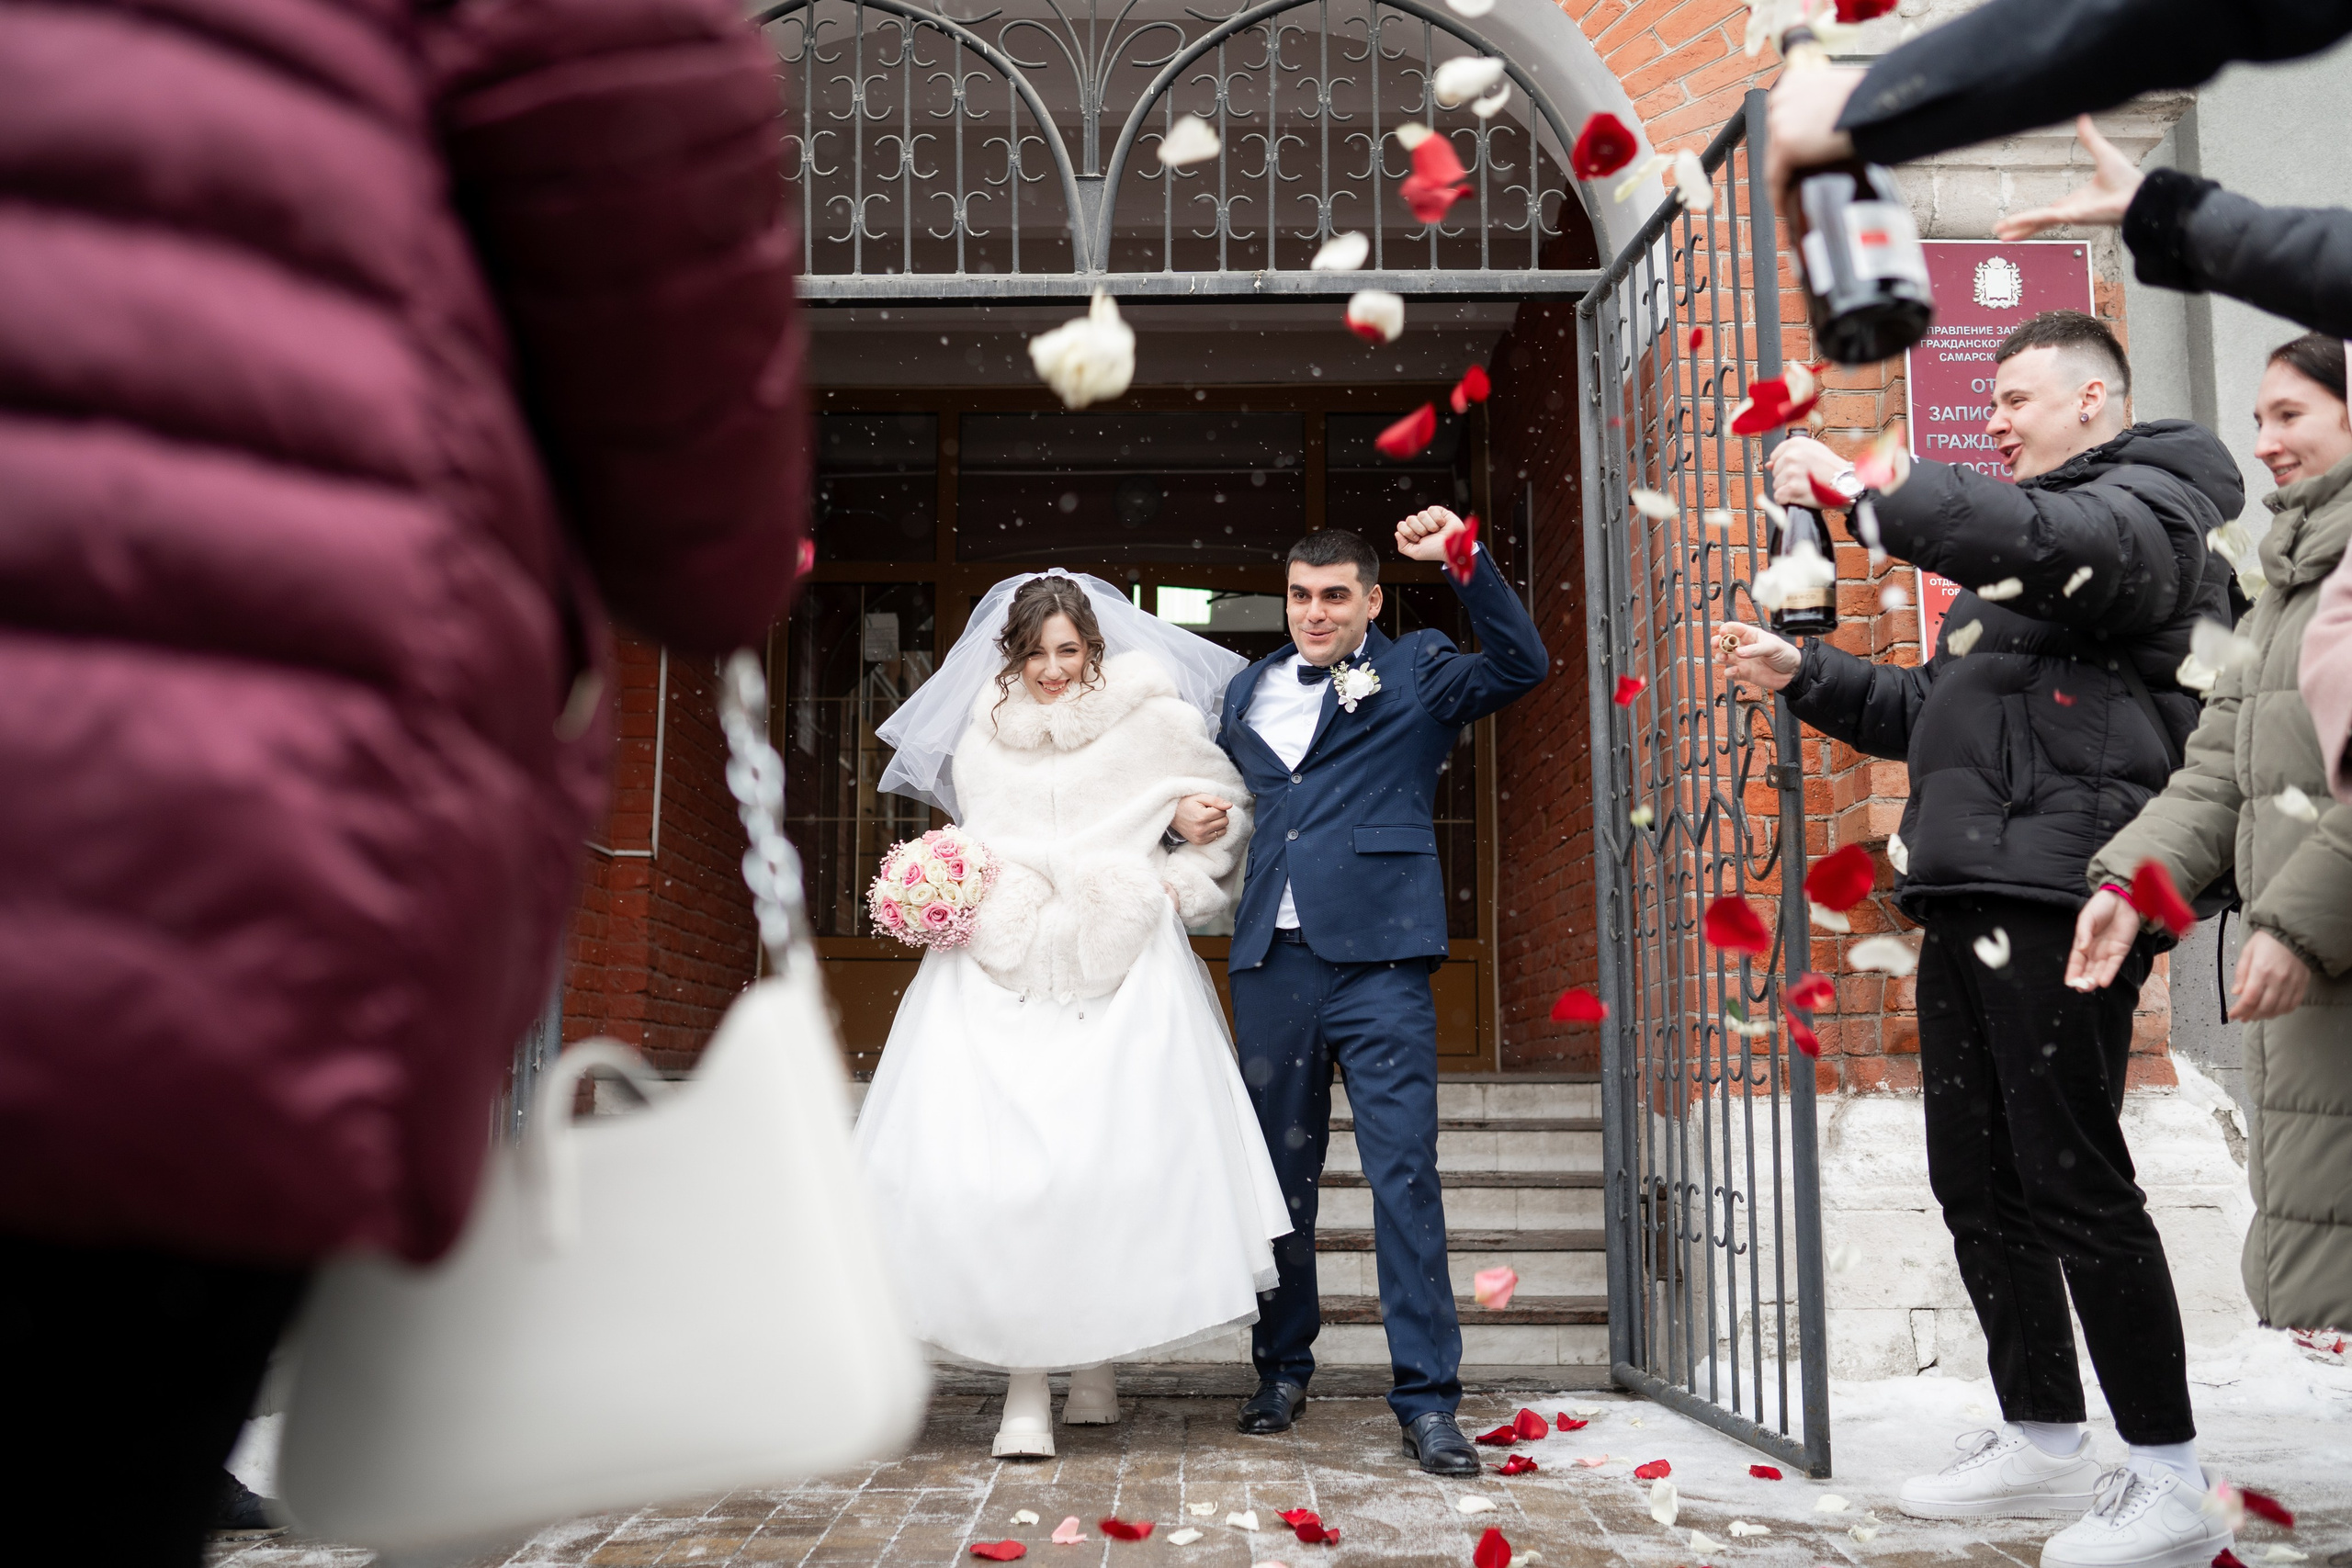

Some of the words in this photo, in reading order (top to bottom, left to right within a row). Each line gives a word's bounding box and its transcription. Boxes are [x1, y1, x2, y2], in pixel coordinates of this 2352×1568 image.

[1927, 326, 1994, 335] ПРАВЛЕНИЕ
[1996, 326, 2020, 335] ЗАП
[1920, 339, 2006, 349] ГРАЖДАНСКОГ
[1971, 378, 1997, 393] ОТ
[1928, 406, 1995, 422] ЗАПИС
[1926, 434, 1998, 451] ГРАЖД
[1929, 578, 1959, 587] ОТДЕ
[1941, 588, 1961, 596] ГОР
